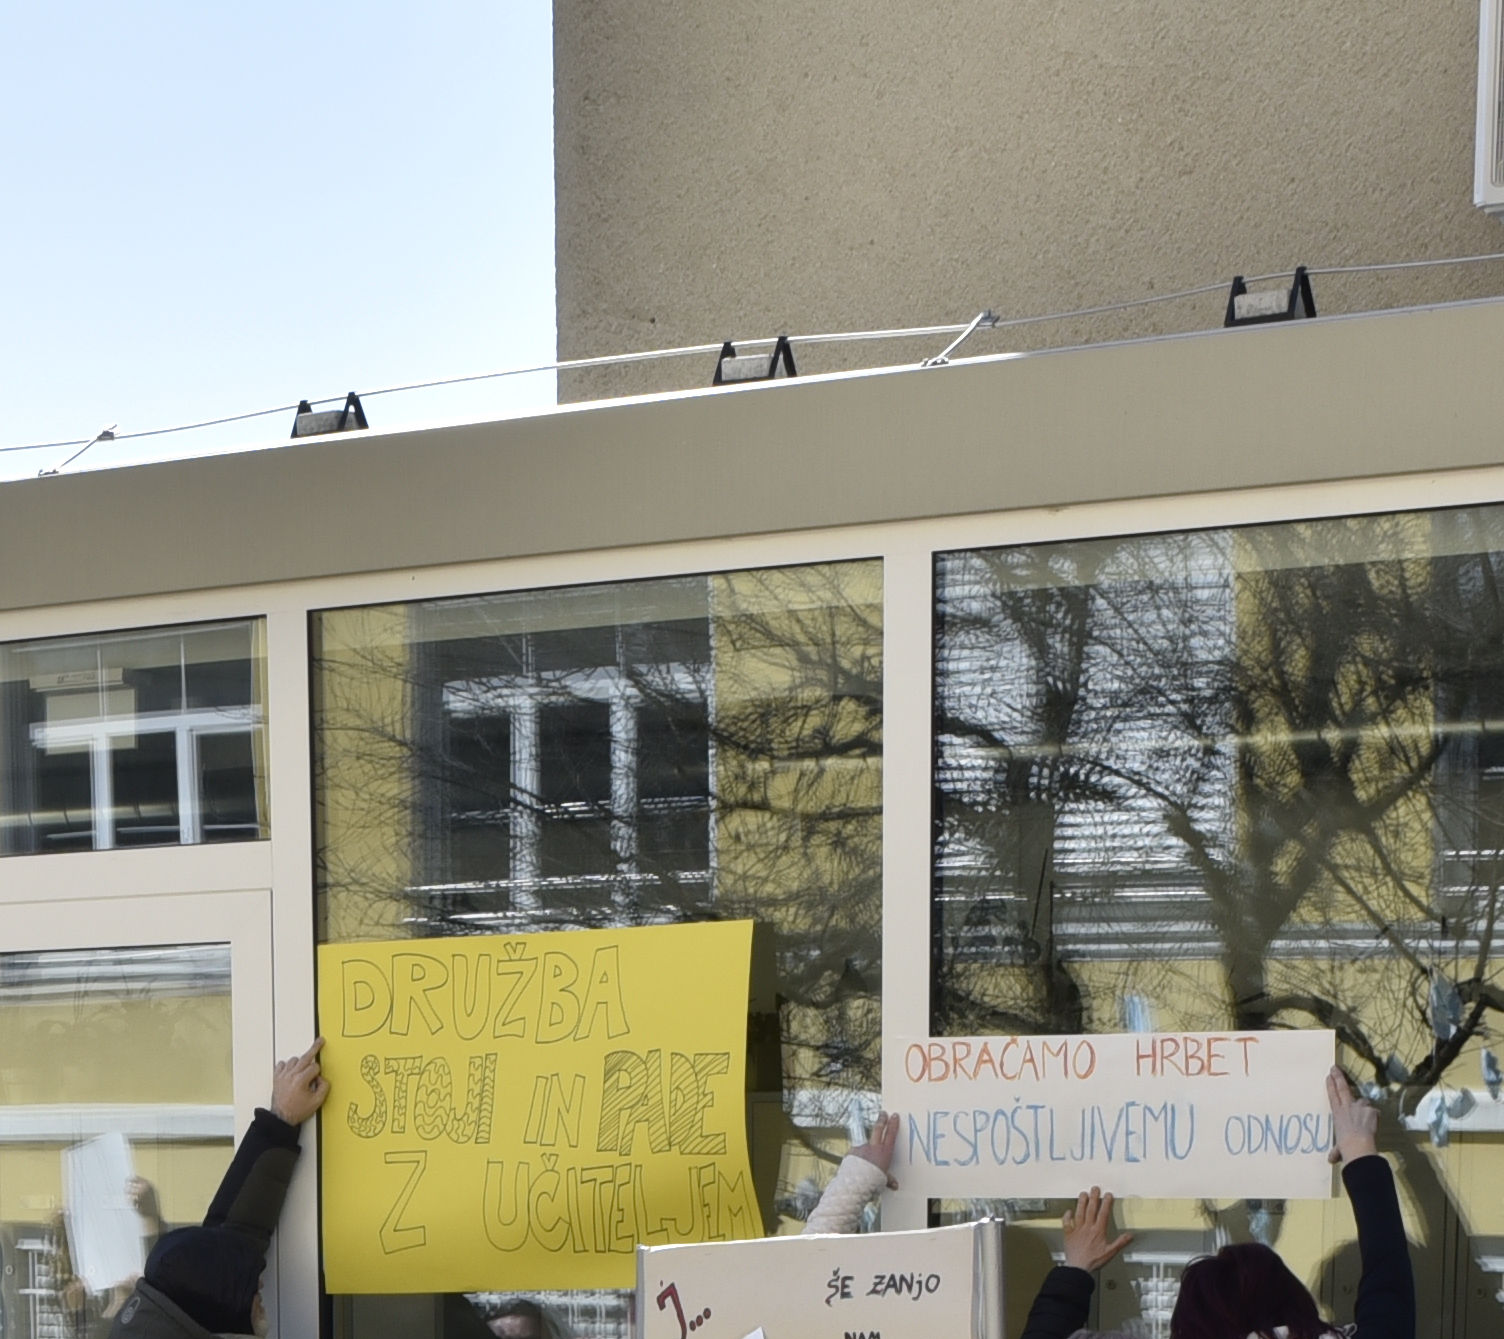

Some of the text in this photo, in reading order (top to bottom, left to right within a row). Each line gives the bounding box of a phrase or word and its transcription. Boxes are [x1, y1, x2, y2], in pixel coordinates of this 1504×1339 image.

[342, 942, 630, 1043] DRUŽBA
[905, 1036, 1259, 1082] OBRAČAMO HRBET
[347, 1048, 730, 1156] STOJI IN PADE
[908, 1097, 1334, 1167] NESPOŠTLJIVEMU ODNOSU
[379, 1150, 762, 1254] Z UČITELJEM
[825, 1268, 853, 1307] ŠE
